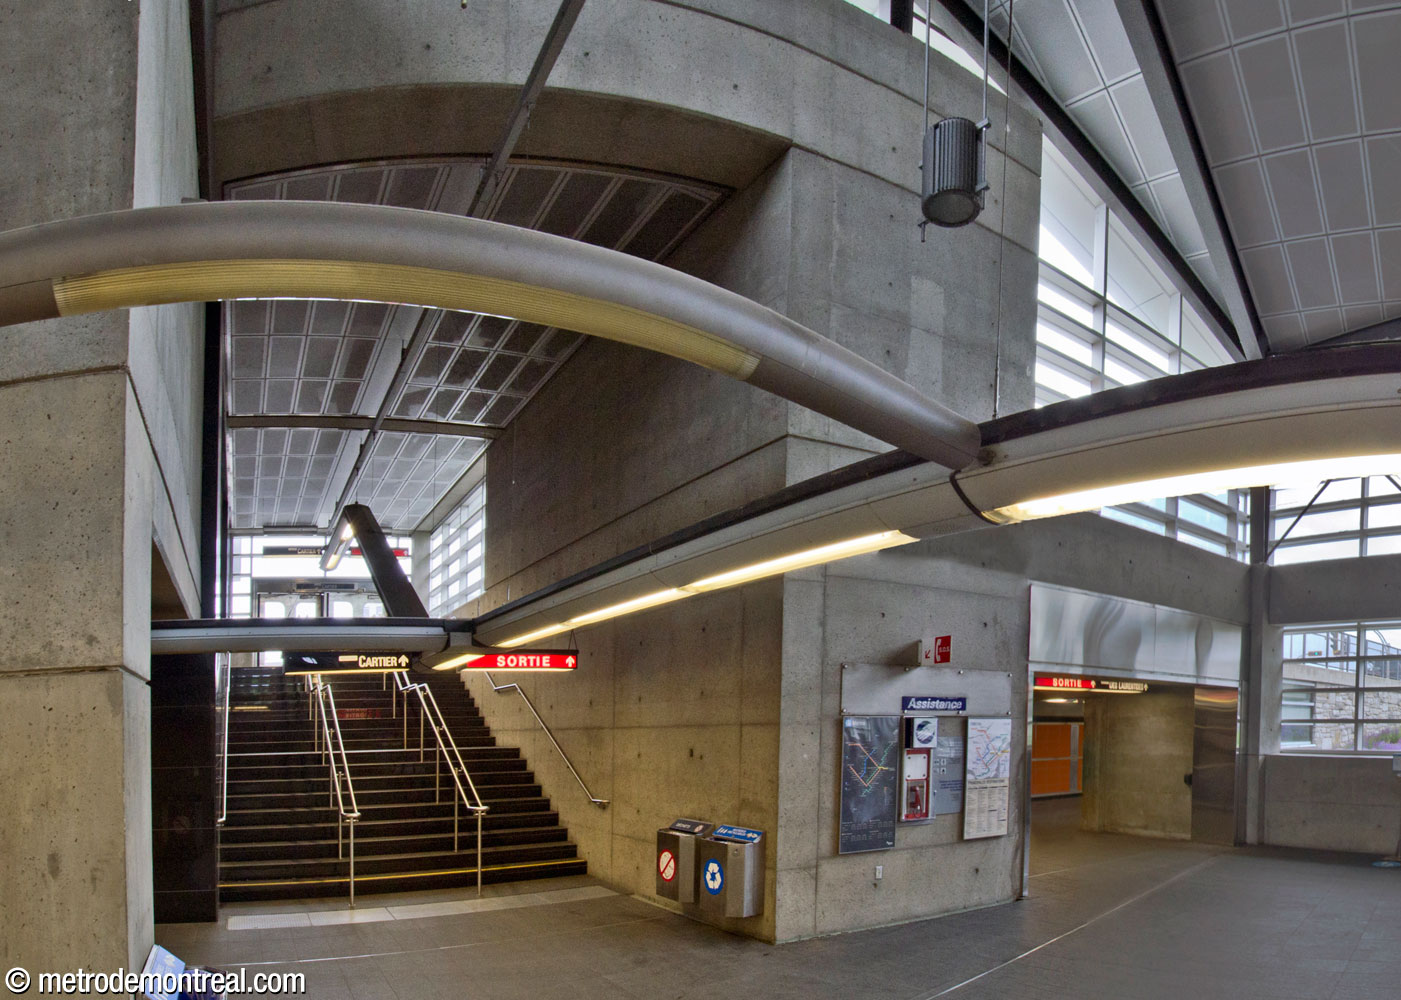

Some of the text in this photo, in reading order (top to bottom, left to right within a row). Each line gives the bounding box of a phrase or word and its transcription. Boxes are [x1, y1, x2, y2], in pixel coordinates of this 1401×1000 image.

[358, 655, 398, 667] CARTIER
[496, 655, 551, 667] SORTIE
[1052, 677, 1082, 688] SORTIE
[907, 697, 963, 709] Assistance
